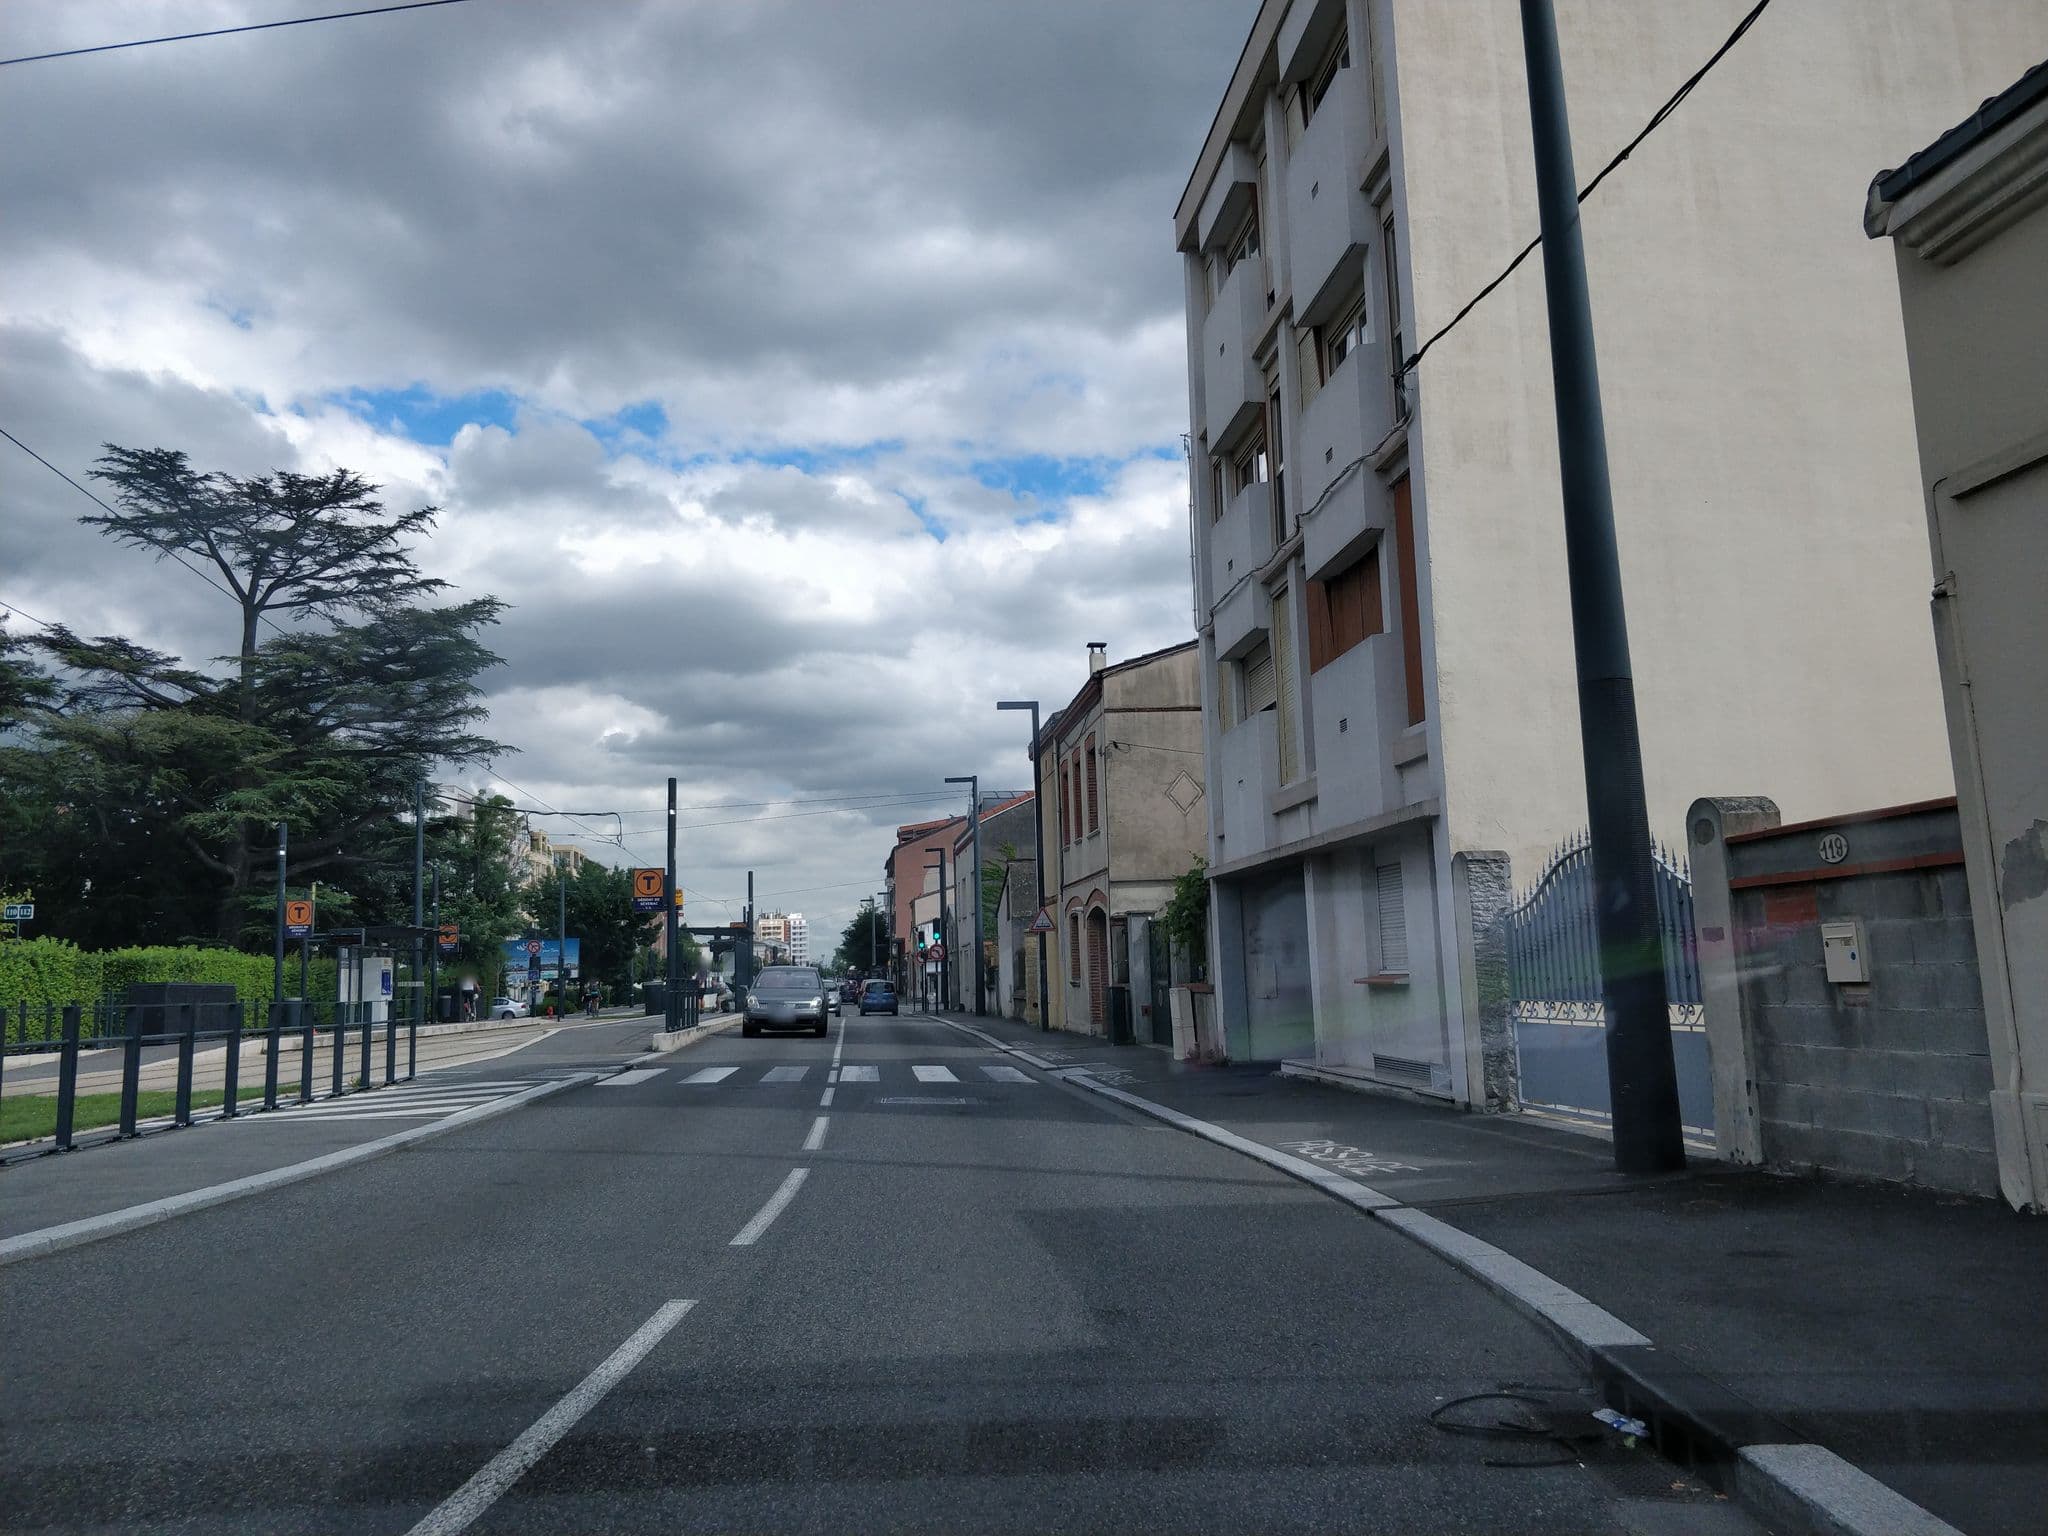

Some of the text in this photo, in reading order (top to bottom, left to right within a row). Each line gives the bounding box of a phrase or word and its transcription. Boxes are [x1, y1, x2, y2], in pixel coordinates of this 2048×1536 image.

[1820, 837, 1843, 860] 119
[643, 876, 655, 890] T
[20, 908, 31, 916] 112
[294, 906, 305, 919] T
